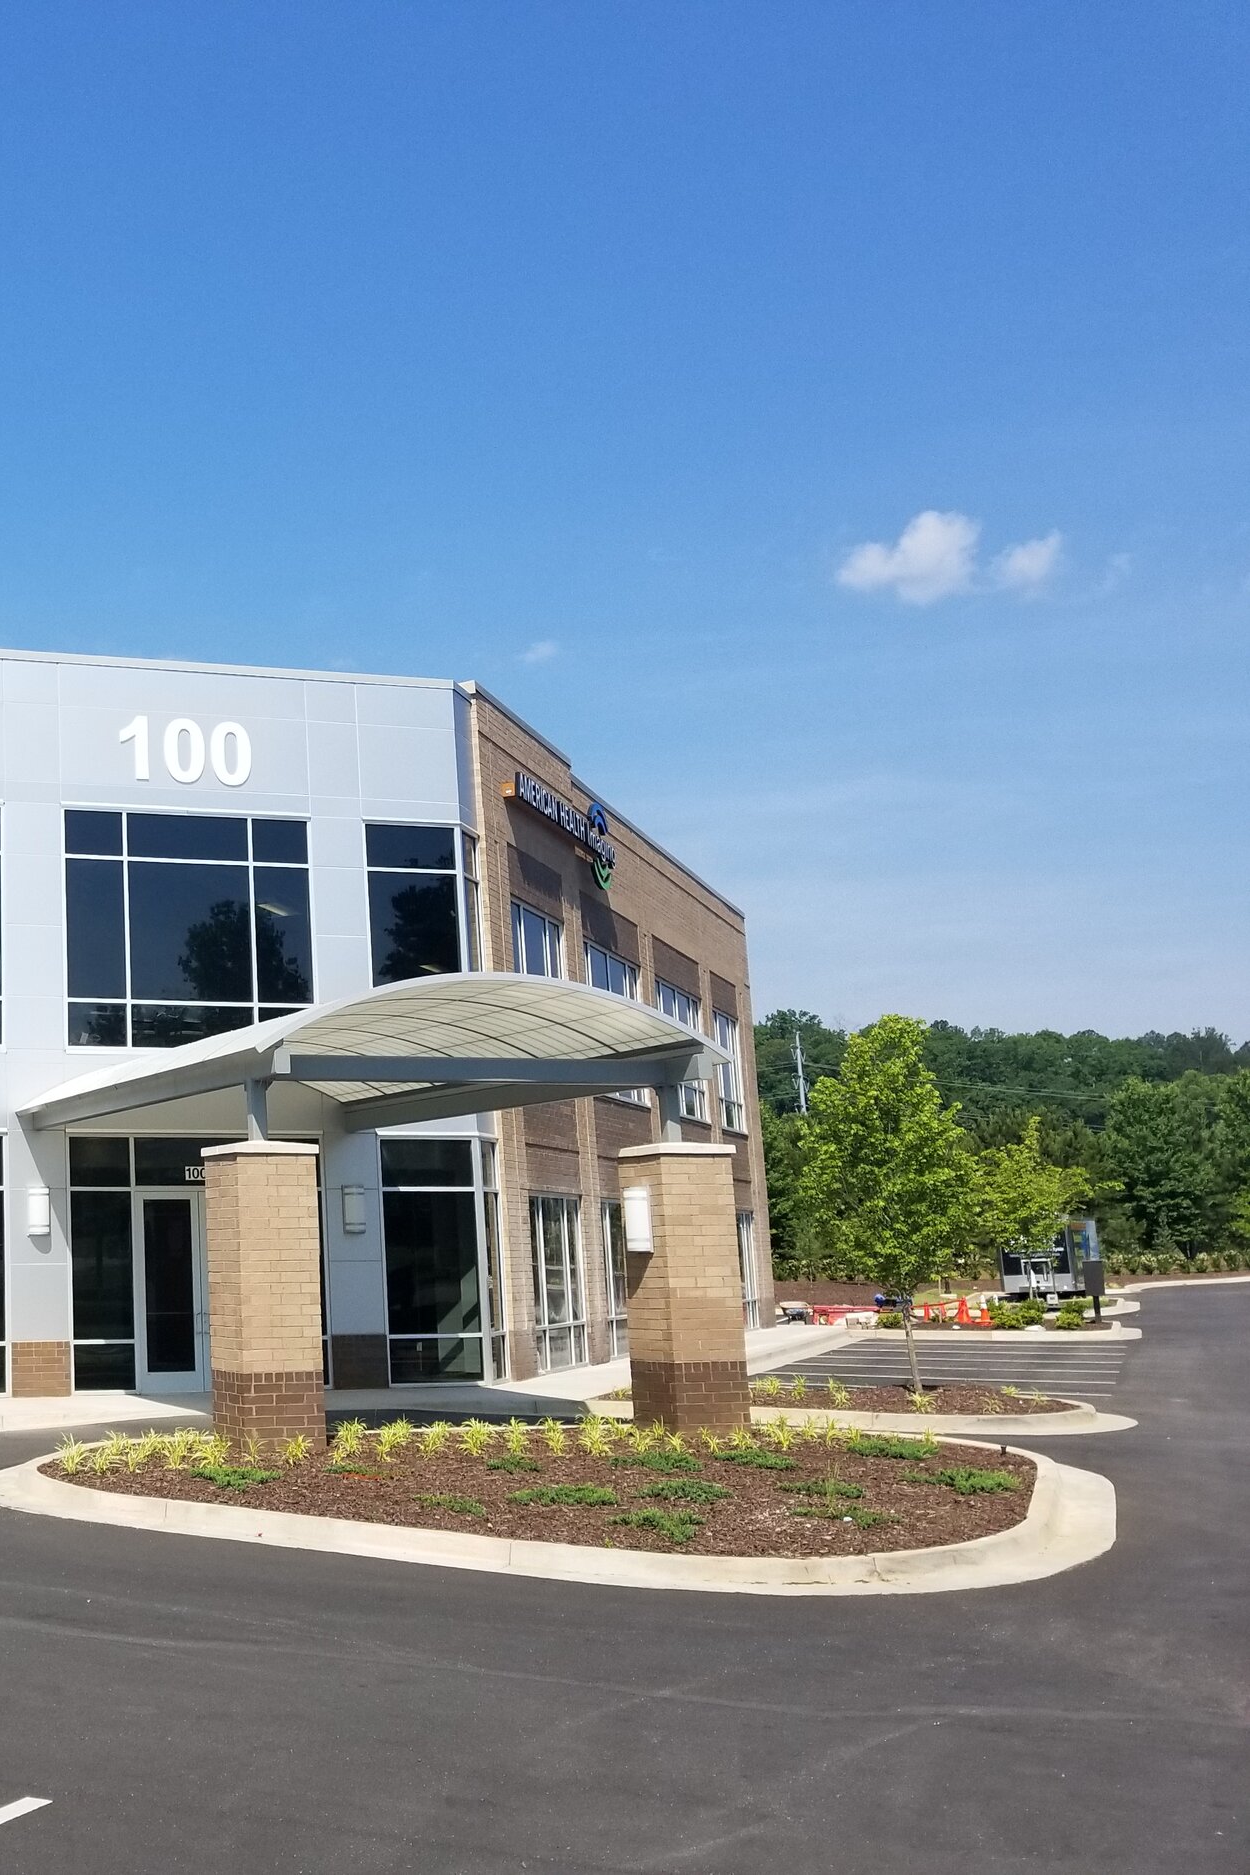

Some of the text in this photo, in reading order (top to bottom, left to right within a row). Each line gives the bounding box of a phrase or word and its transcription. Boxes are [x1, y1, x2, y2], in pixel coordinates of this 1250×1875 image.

[119, 715, 252, 787] 100
[519, 772, 616, 870] AMERICAN HEALTH Imaging
